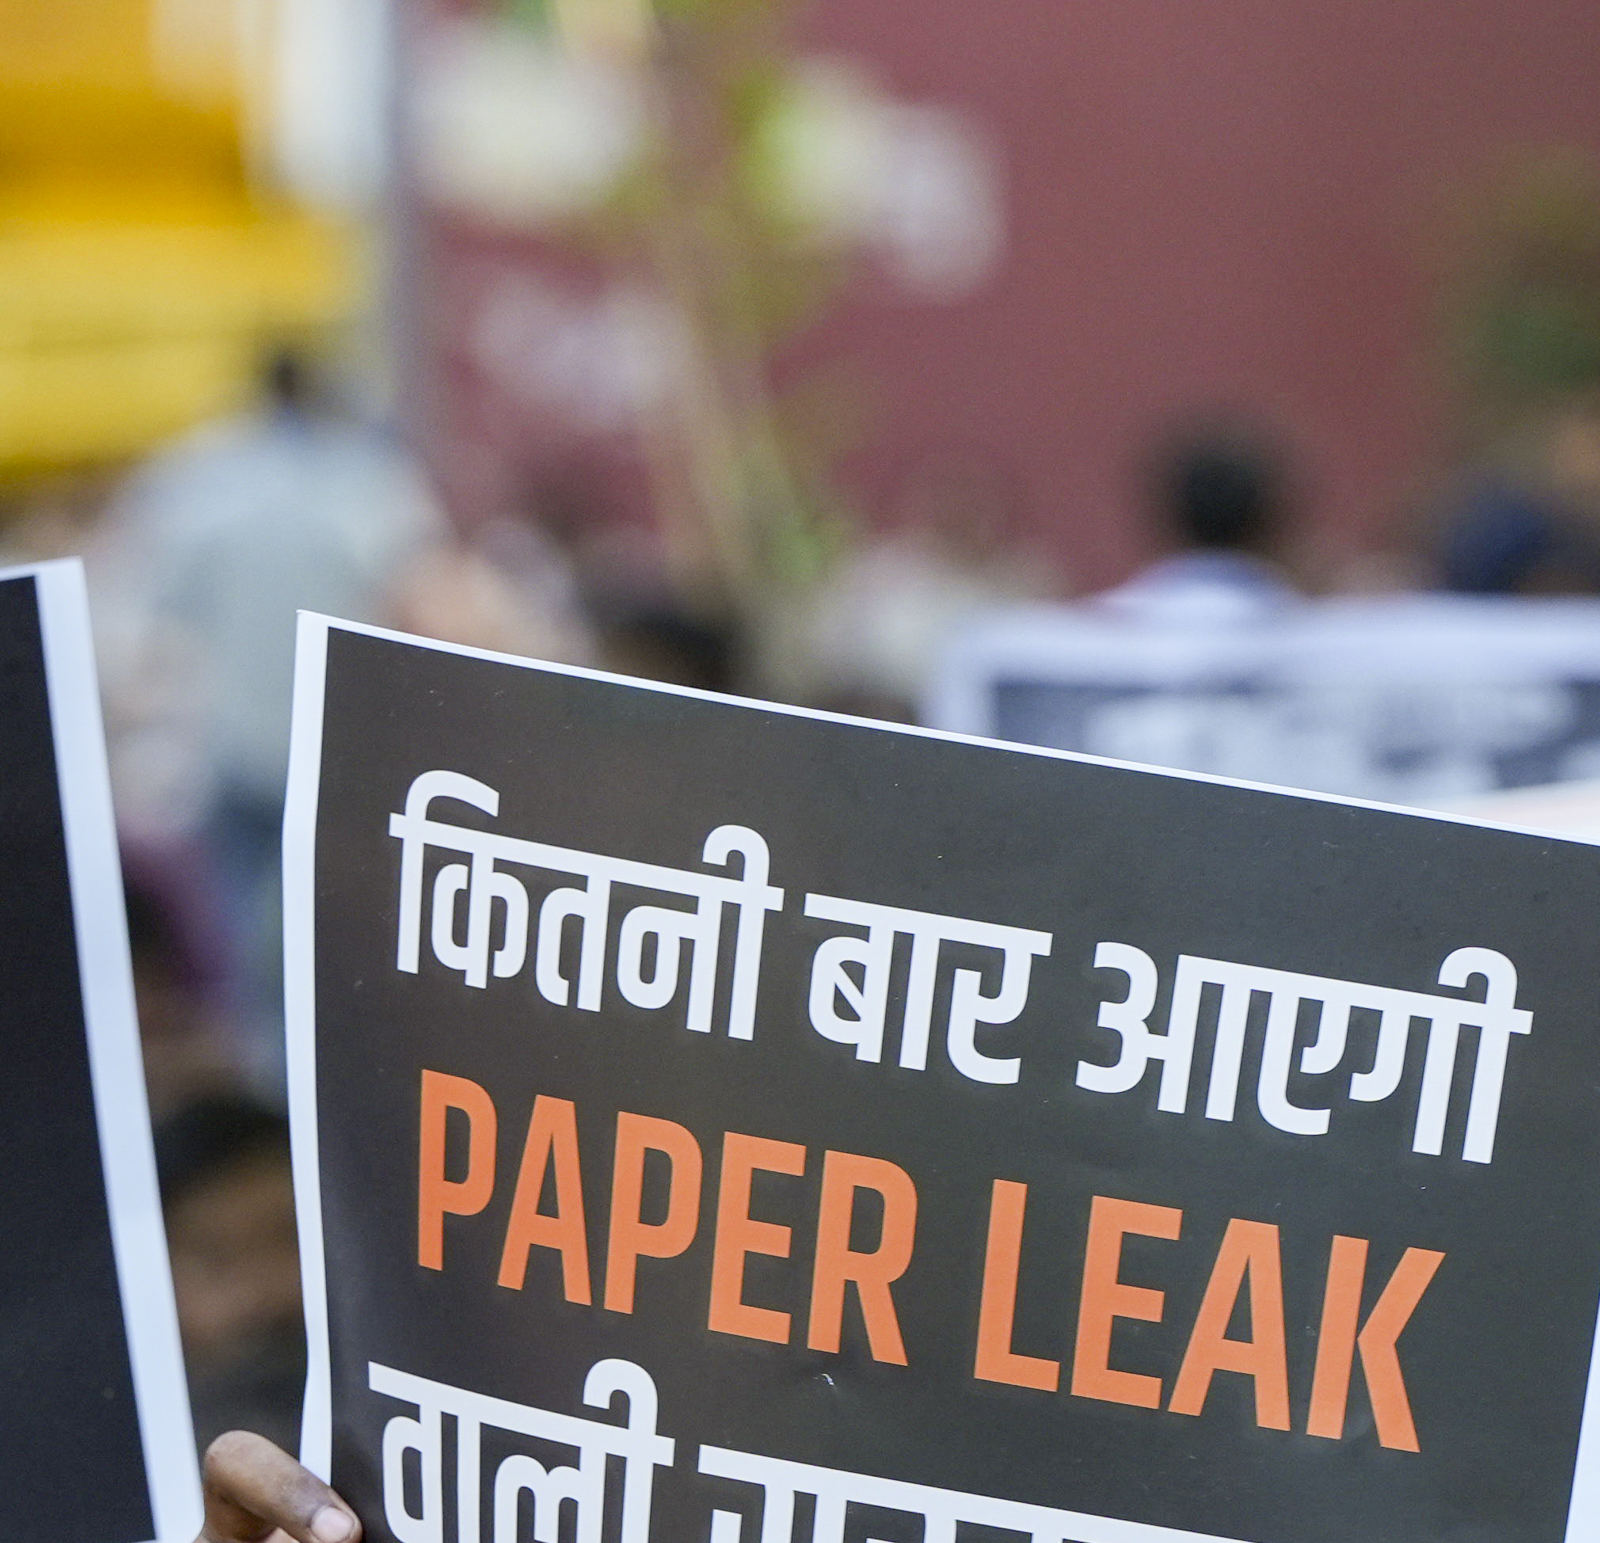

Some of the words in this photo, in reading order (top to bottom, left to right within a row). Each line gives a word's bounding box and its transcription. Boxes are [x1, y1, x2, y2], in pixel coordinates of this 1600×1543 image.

[388, 769, 785, 1041] कितनी
[803, 892, 1054, 1085] बार
[1075, 941, 1534, 1164] आएगी
[417, 1068, 919, 1367] PAPER
[973, 1178, 1446, 1453] LEAK
